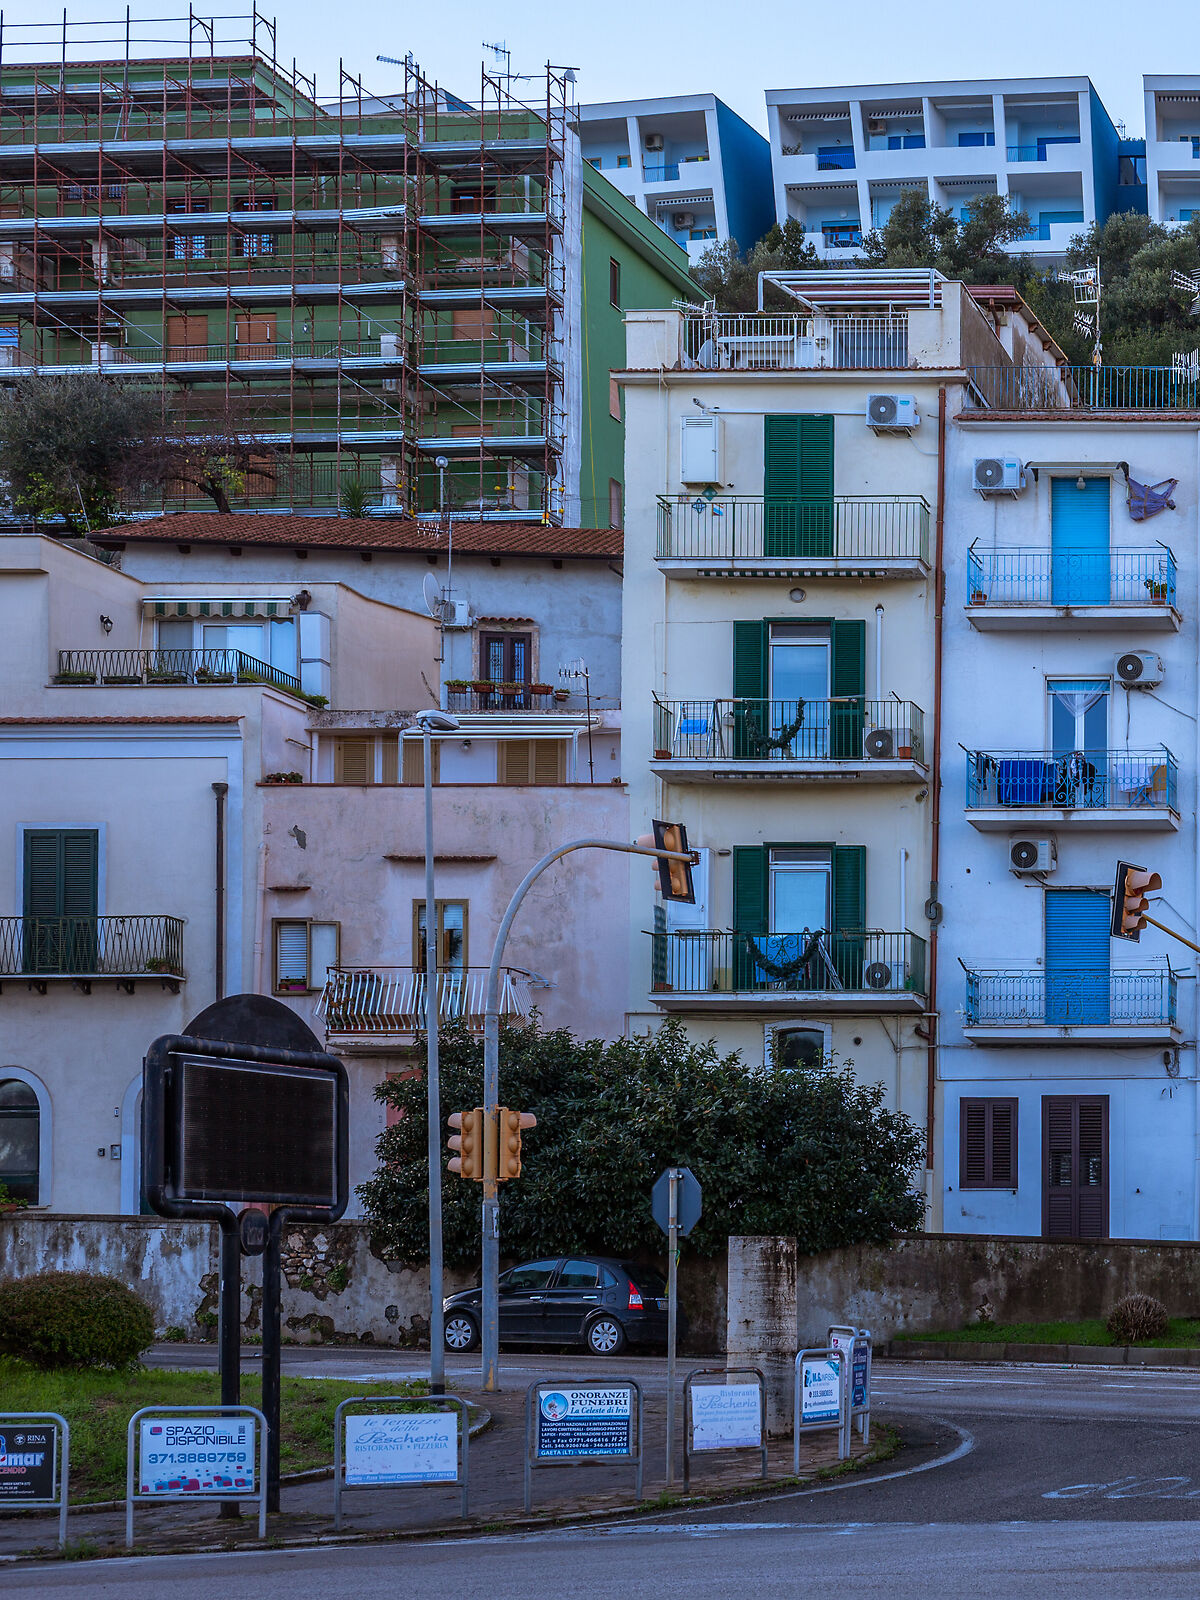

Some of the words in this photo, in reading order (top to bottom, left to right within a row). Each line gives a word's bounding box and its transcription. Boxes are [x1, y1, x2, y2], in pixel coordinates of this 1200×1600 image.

[571, 1391, 629, 1399] ONORANZE
[697, 1394, 757, 1409] Pescheria
[570, 1406, 580, 1414] La
[581, 1406, 606, 1414] Celeste
[166, 1425, 215, 1436] SPAZIO
[27, 1434, 46, 1442] RINA
[166, 1435, 246, 1446] DISPONIBILE
[353, 1431, 449, 1445] Pescheria
[355, 1444, 403, 1453] RISTORANTE
[413, 1442, 448, 1450] PIZZERIA
